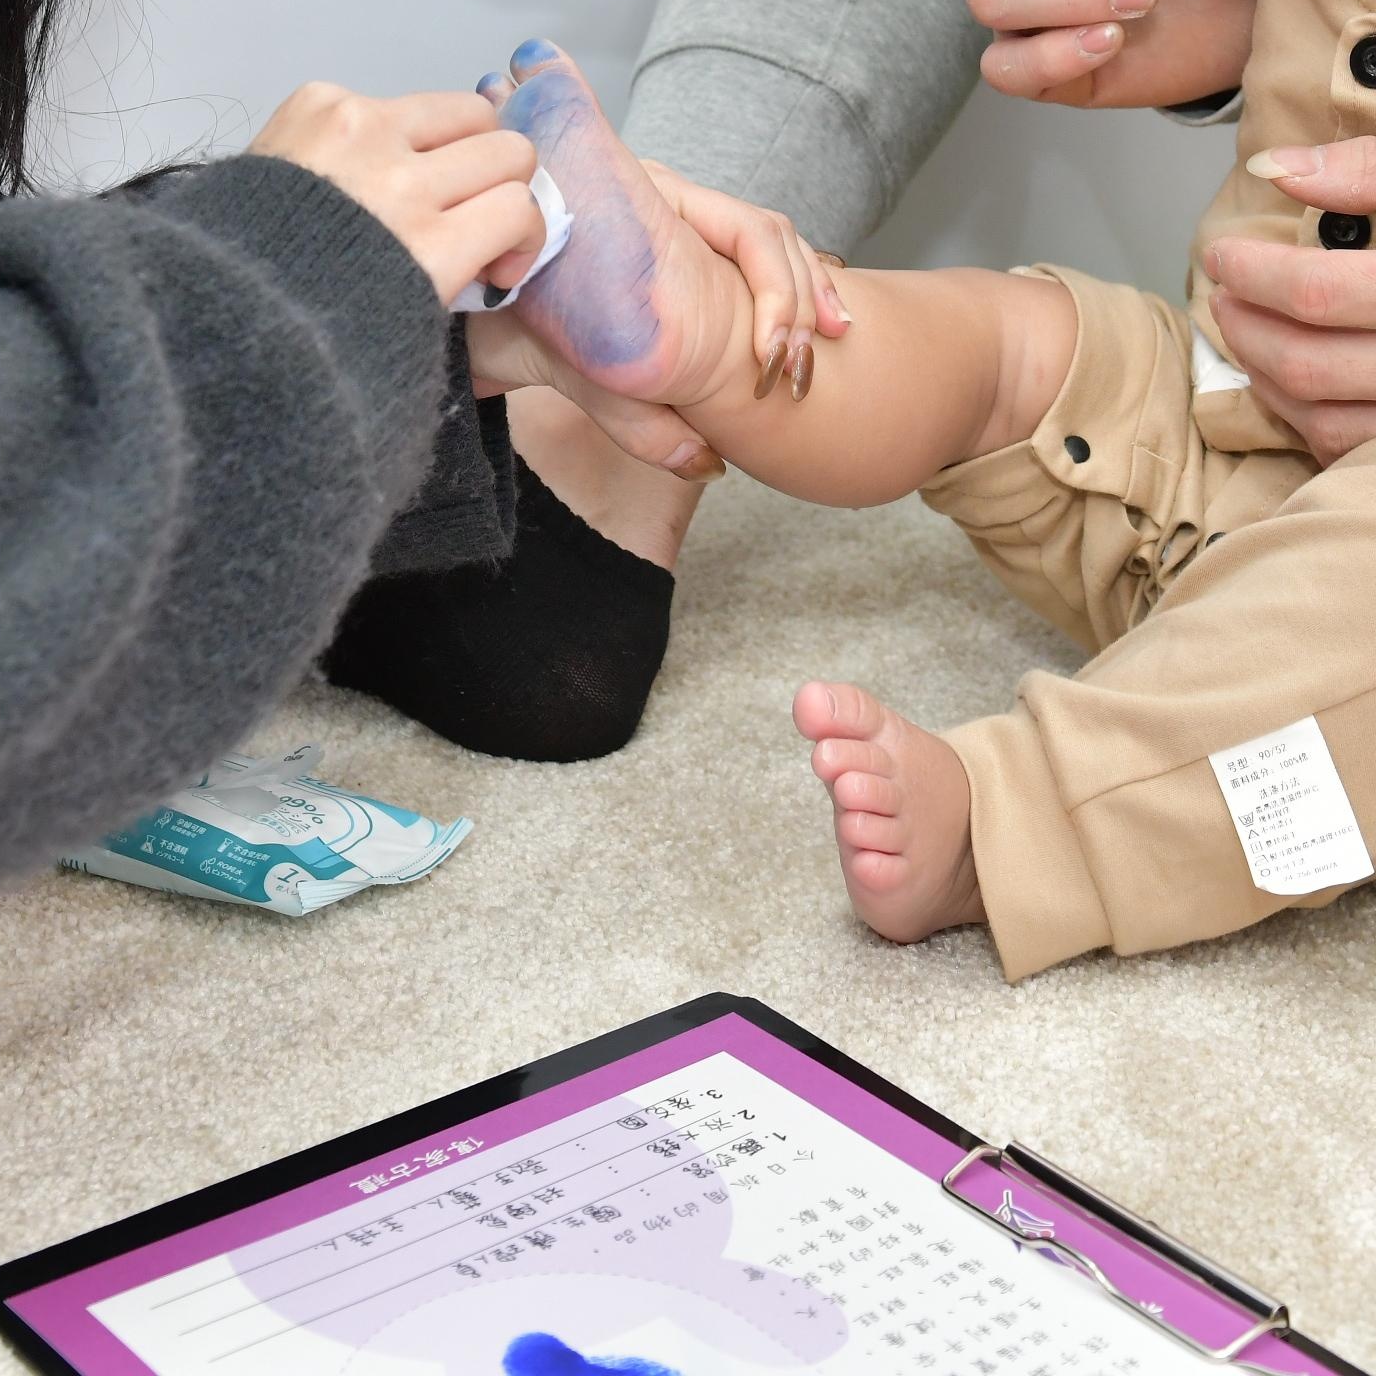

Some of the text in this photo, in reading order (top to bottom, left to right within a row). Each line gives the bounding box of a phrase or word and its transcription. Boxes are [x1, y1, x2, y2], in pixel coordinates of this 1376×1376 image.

[1258, 743, 1287, 761] 90/52
[697, 1087, 724, 1102] 3.
[730, 1107, 758, 1122] 2.
[762, 1130, 788, 1145] 1.
[349, 1135, 486, 1197] 傳家古禮
[741, 1198, 902, 1286] 對國家和社會
